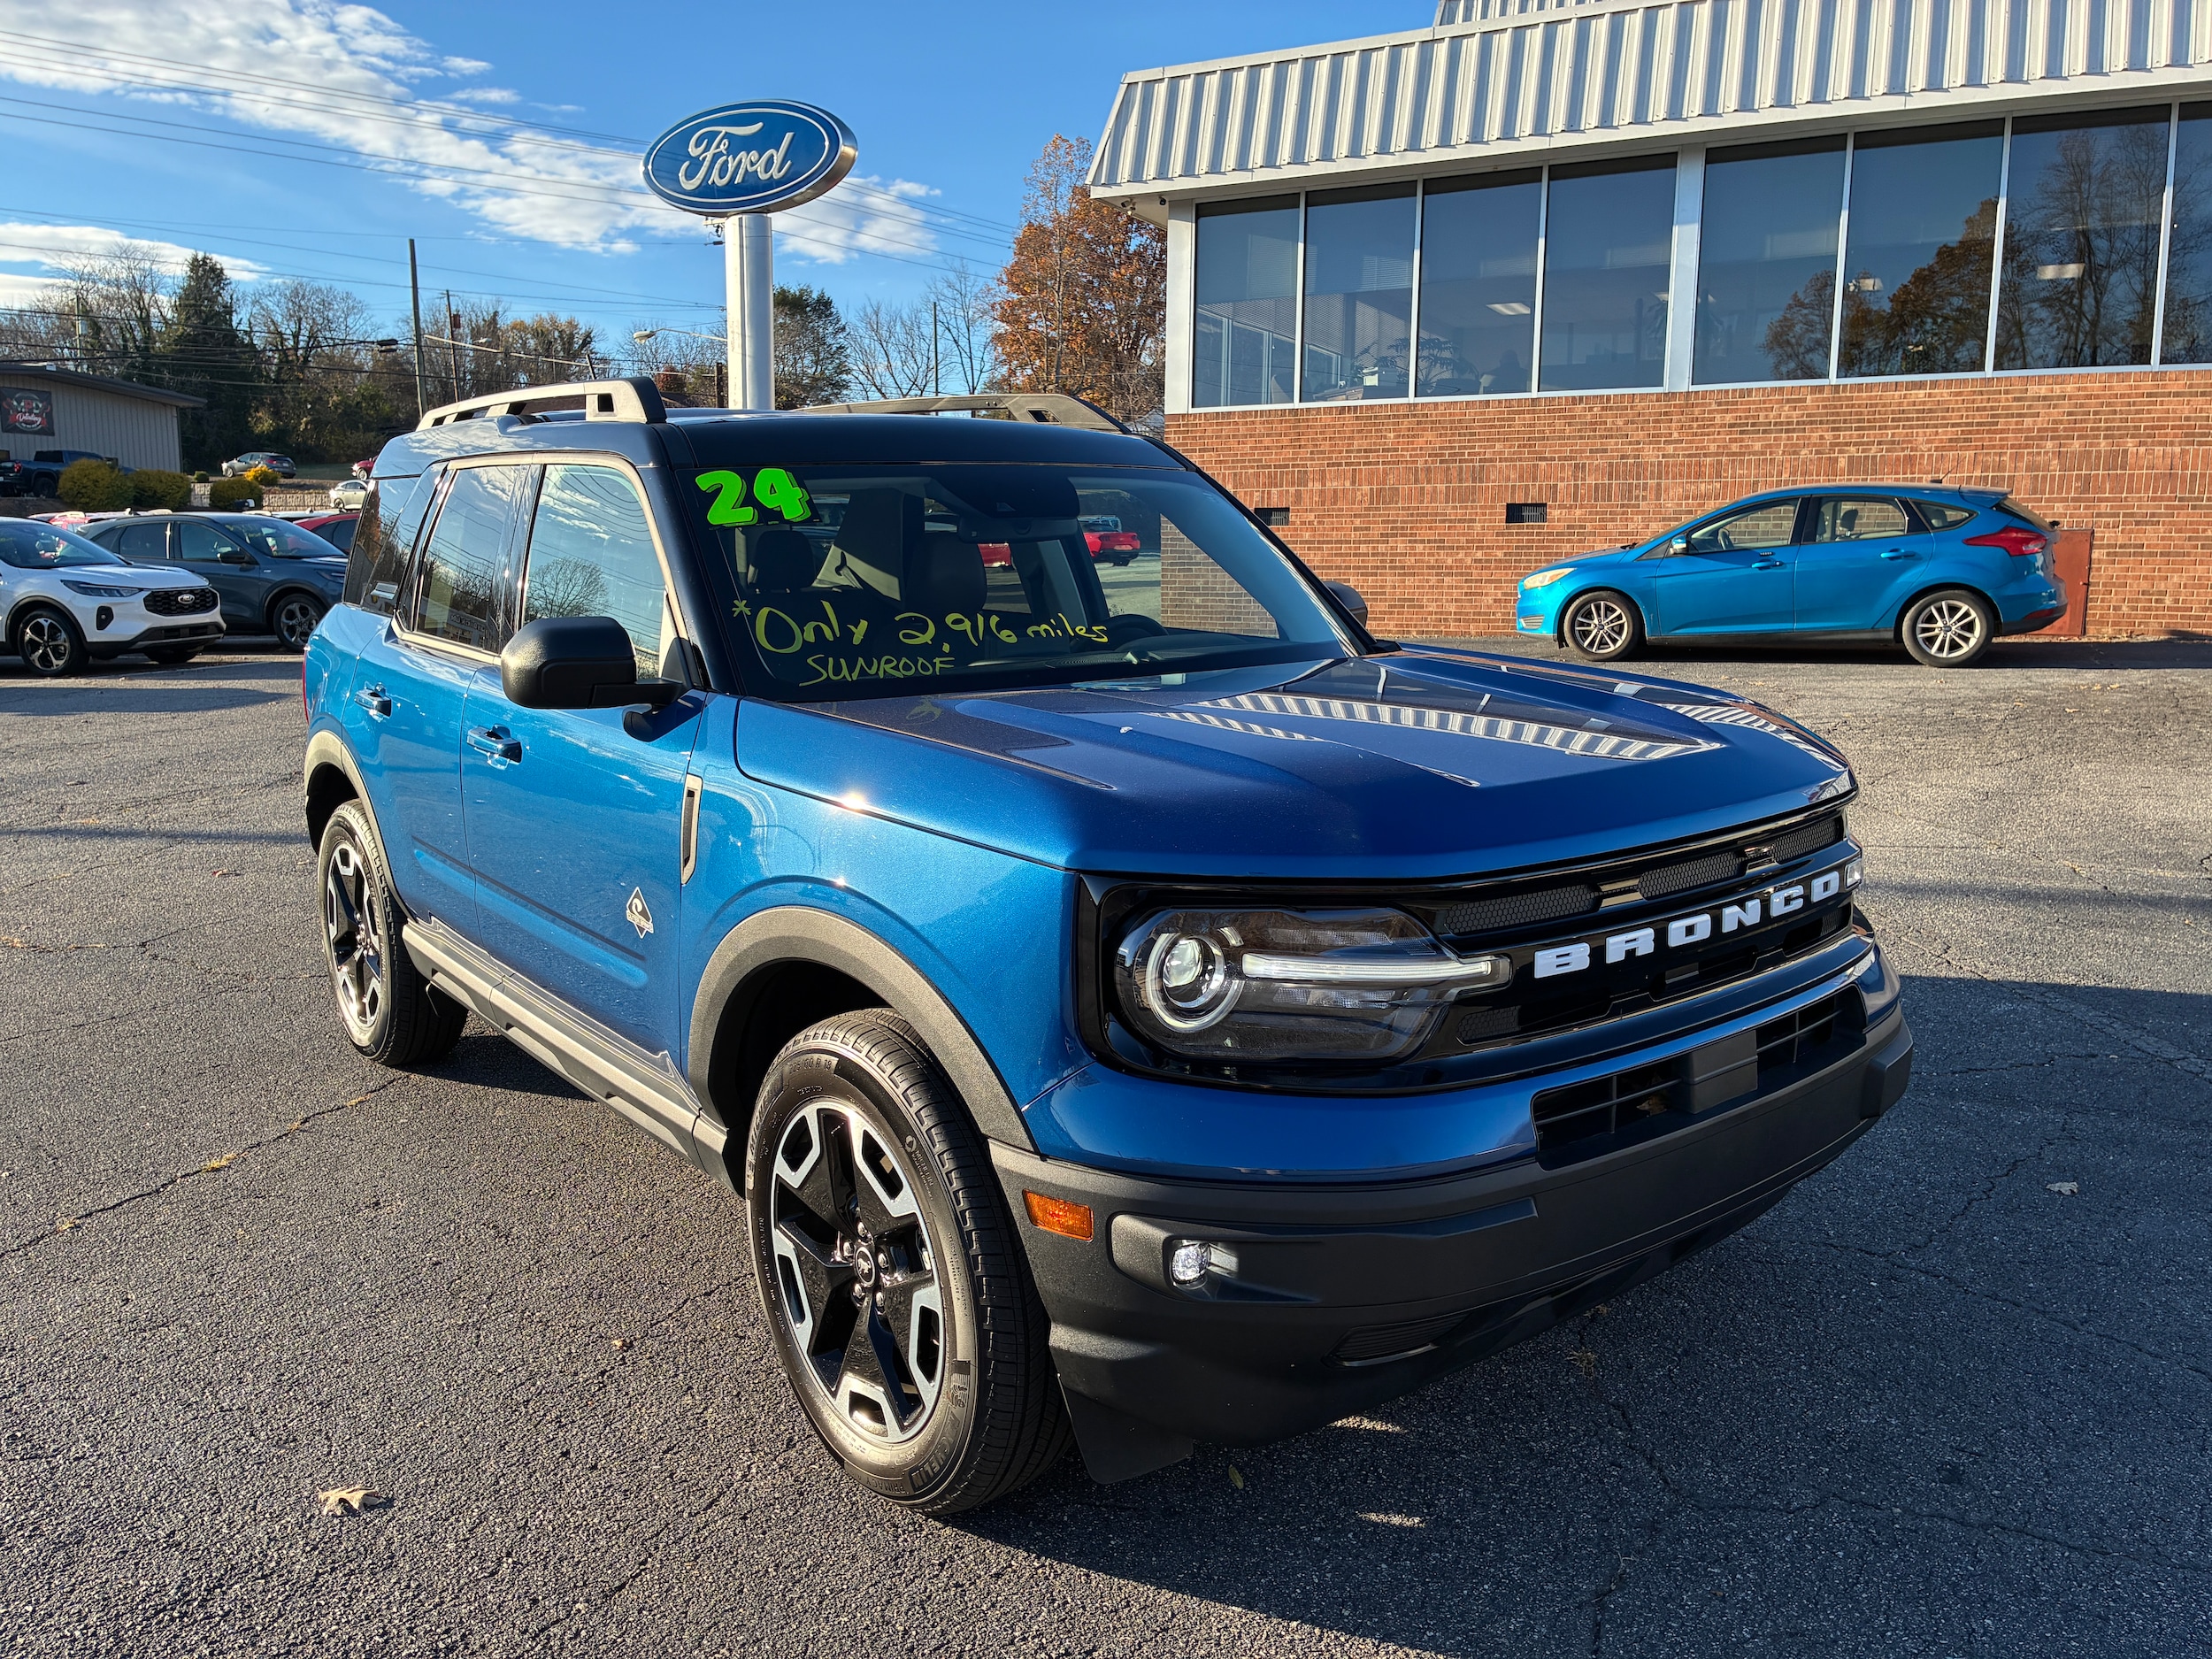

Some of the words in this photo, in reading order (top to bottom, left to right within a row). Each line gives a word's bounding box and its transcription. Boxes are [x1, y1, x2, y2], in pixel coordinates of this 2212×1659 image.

[679, 121, 795, 191] Ford
[695, 467, 811, 526] 24
[1026, 612, 1110, 644] miles
[798, 653, 955, 687] SUNROOF
[1533, 871, 1839, 979] BRONCO
[911, 1410, 961, 1488] MICHELIN
[865, 1475, 905, 1494] PRIMACY
